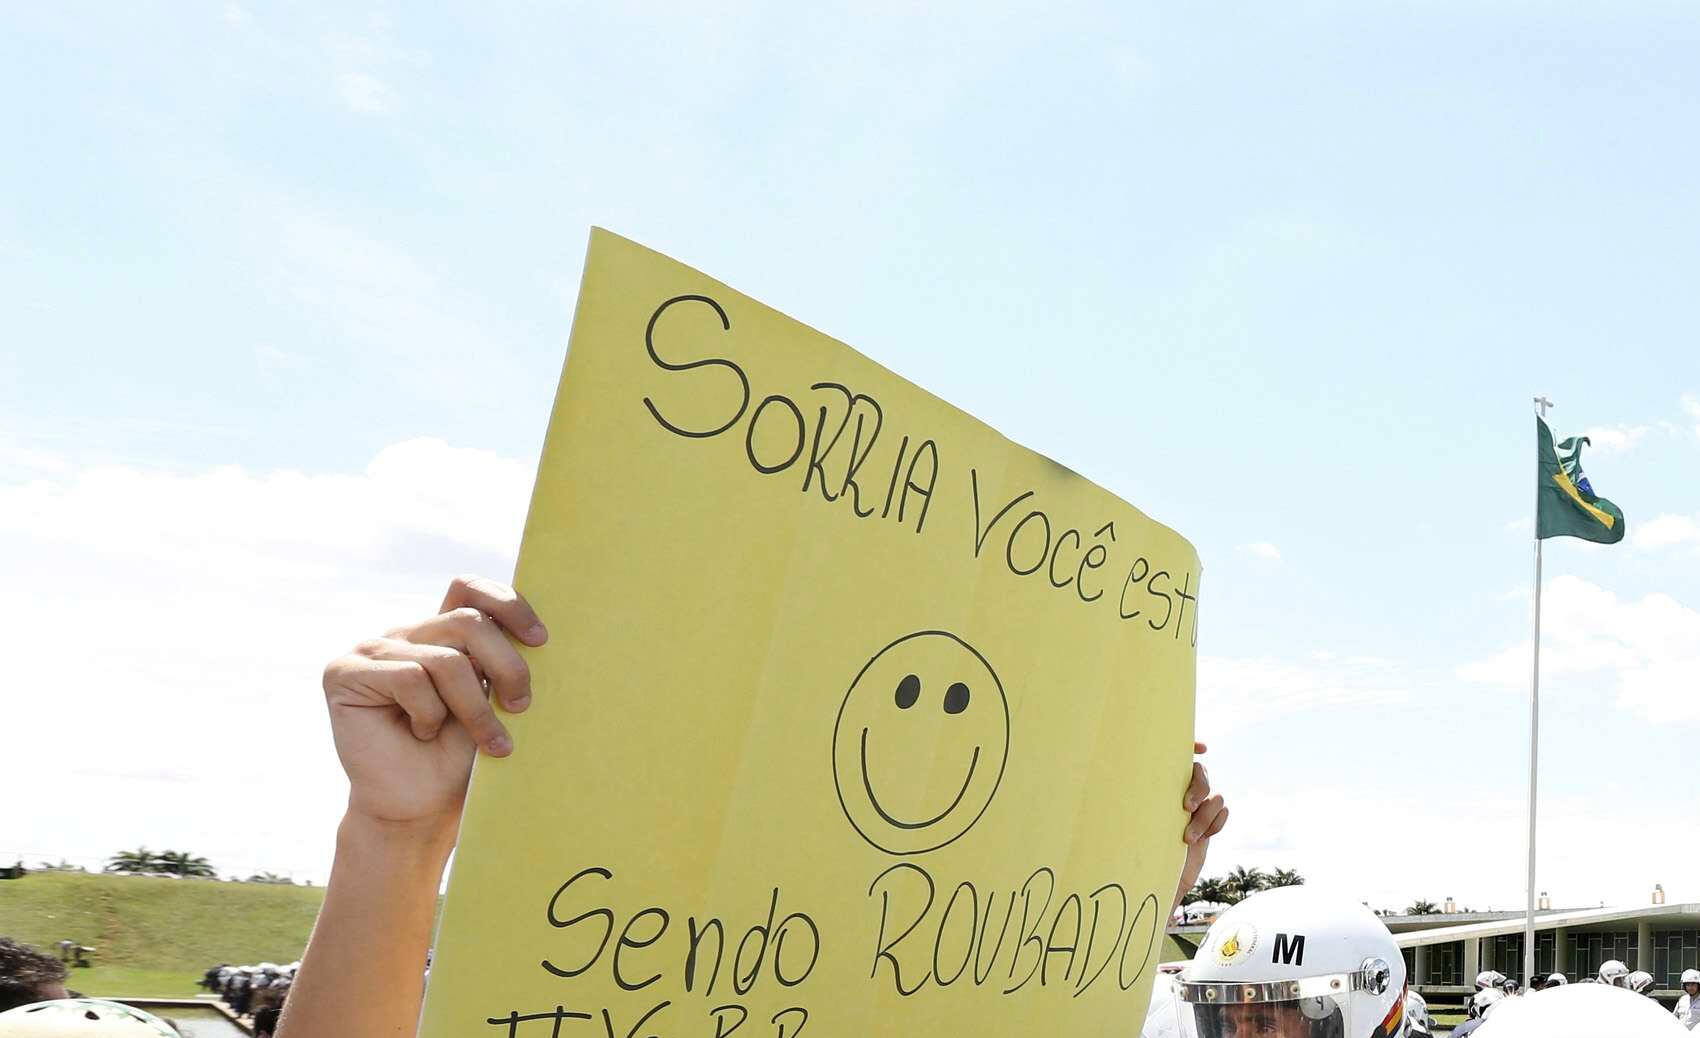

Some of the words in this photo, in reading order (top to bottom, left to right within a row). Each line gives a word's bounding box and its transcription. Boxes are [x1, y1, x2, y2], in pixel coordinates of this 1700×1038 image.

[643, 294, 939, 533] SORRIA
[541, 866, 820, 996] Sendo
[868, 861, 1160, 999] ROUBADO
[1272, 932, 1306, 967] M
